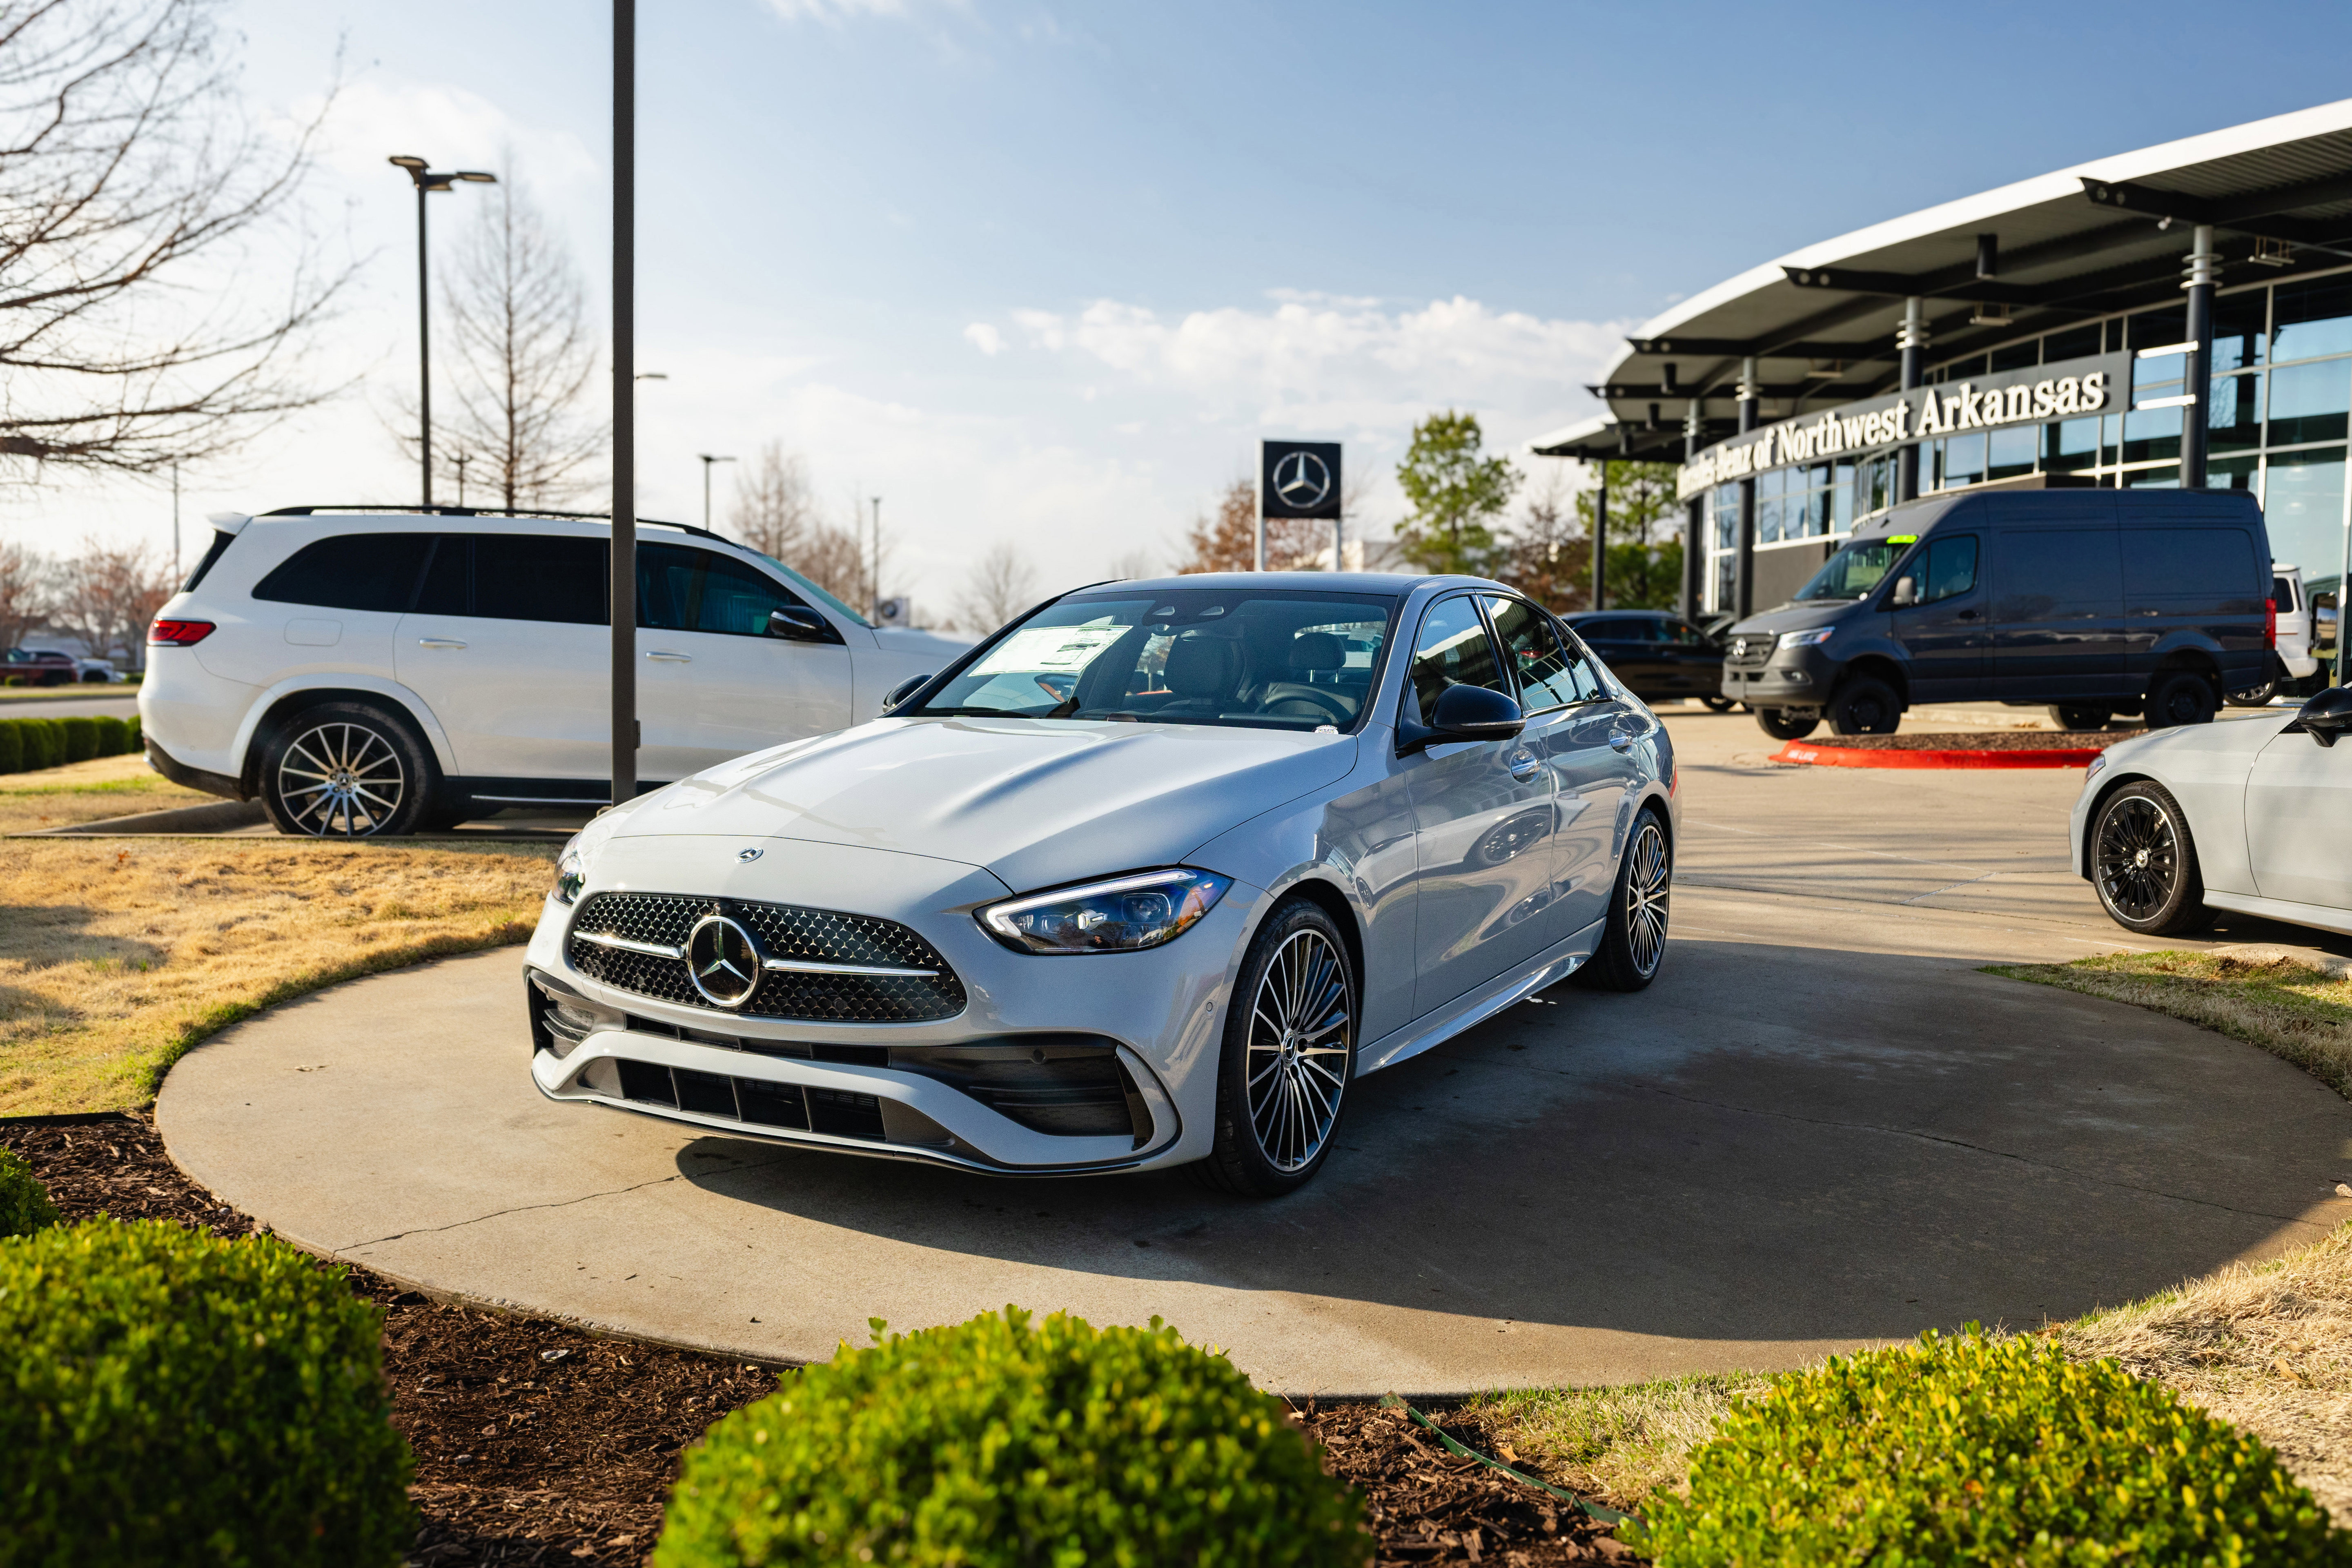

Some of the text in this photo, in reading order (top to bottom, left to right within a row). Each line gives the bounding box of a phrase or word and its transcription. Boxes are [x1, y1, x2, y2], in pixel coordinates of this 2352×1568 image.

[1676, 371, 2104, 501] des-Benz of Northwest Arkansas
